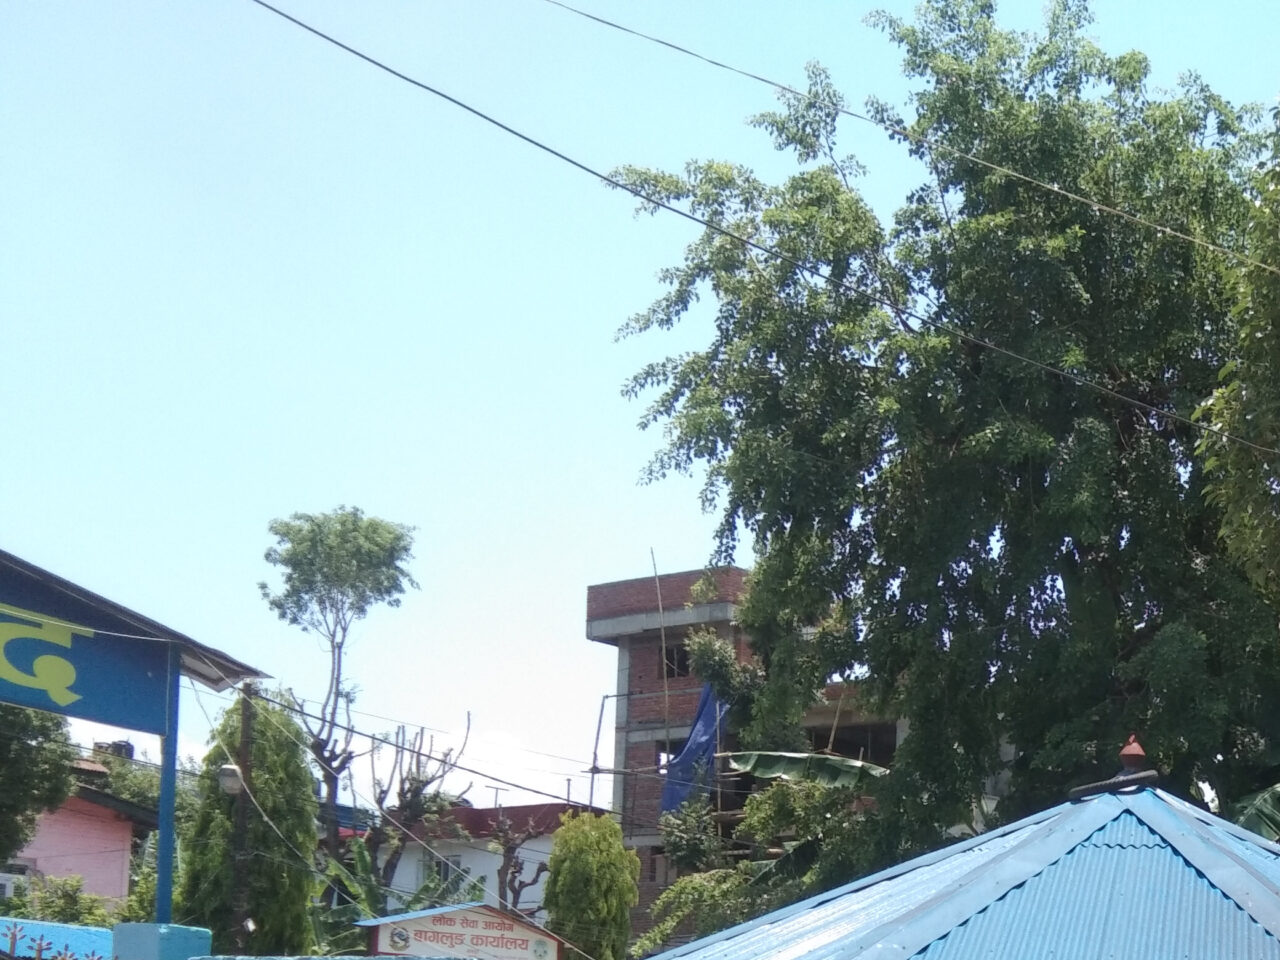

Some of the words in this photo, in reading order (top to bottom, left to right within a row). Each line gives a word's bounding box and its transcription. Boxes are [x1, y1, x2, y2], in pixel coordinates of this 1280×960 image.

[431, 914, 457, 927] लोक
[459, 916, 479, 929] सेवा
[482, 920, 514, 932] आयोग
[469, 933, 529, 951] कार्यालय
